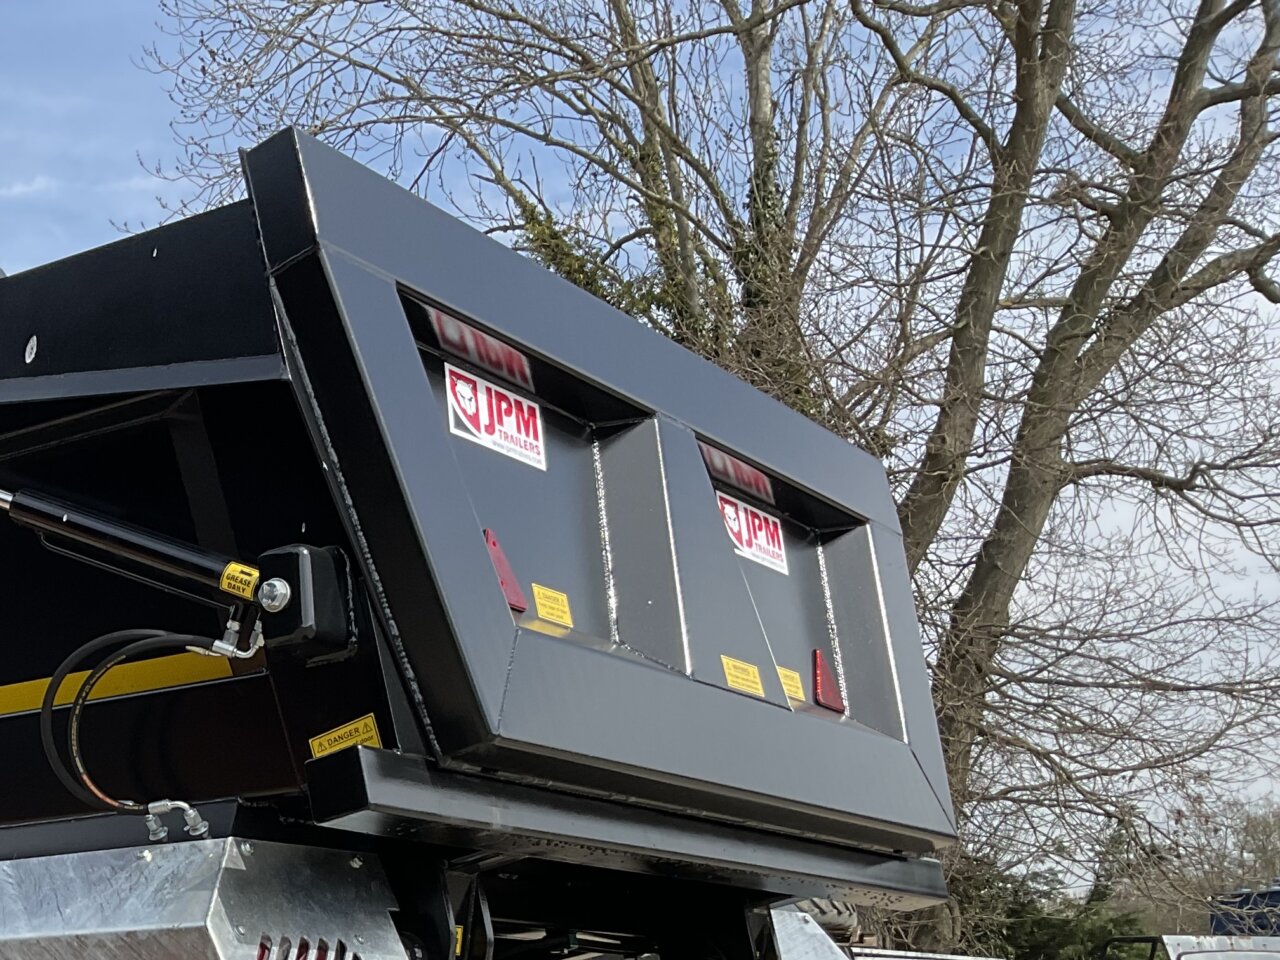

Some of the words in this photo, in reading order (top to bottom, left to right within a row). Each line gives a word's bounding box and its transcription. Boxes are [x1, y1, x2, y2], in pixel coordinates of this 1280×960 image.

[484, 385, 540, 442] JPM
[497, 428, 541, 456] TRAILERS
[745, 506, 782, 551] JPM
[225, 572, 252, 588] GREASE
[227, 581, 246, 593] DAILY
[327, 727, 360, 746] DANGER
